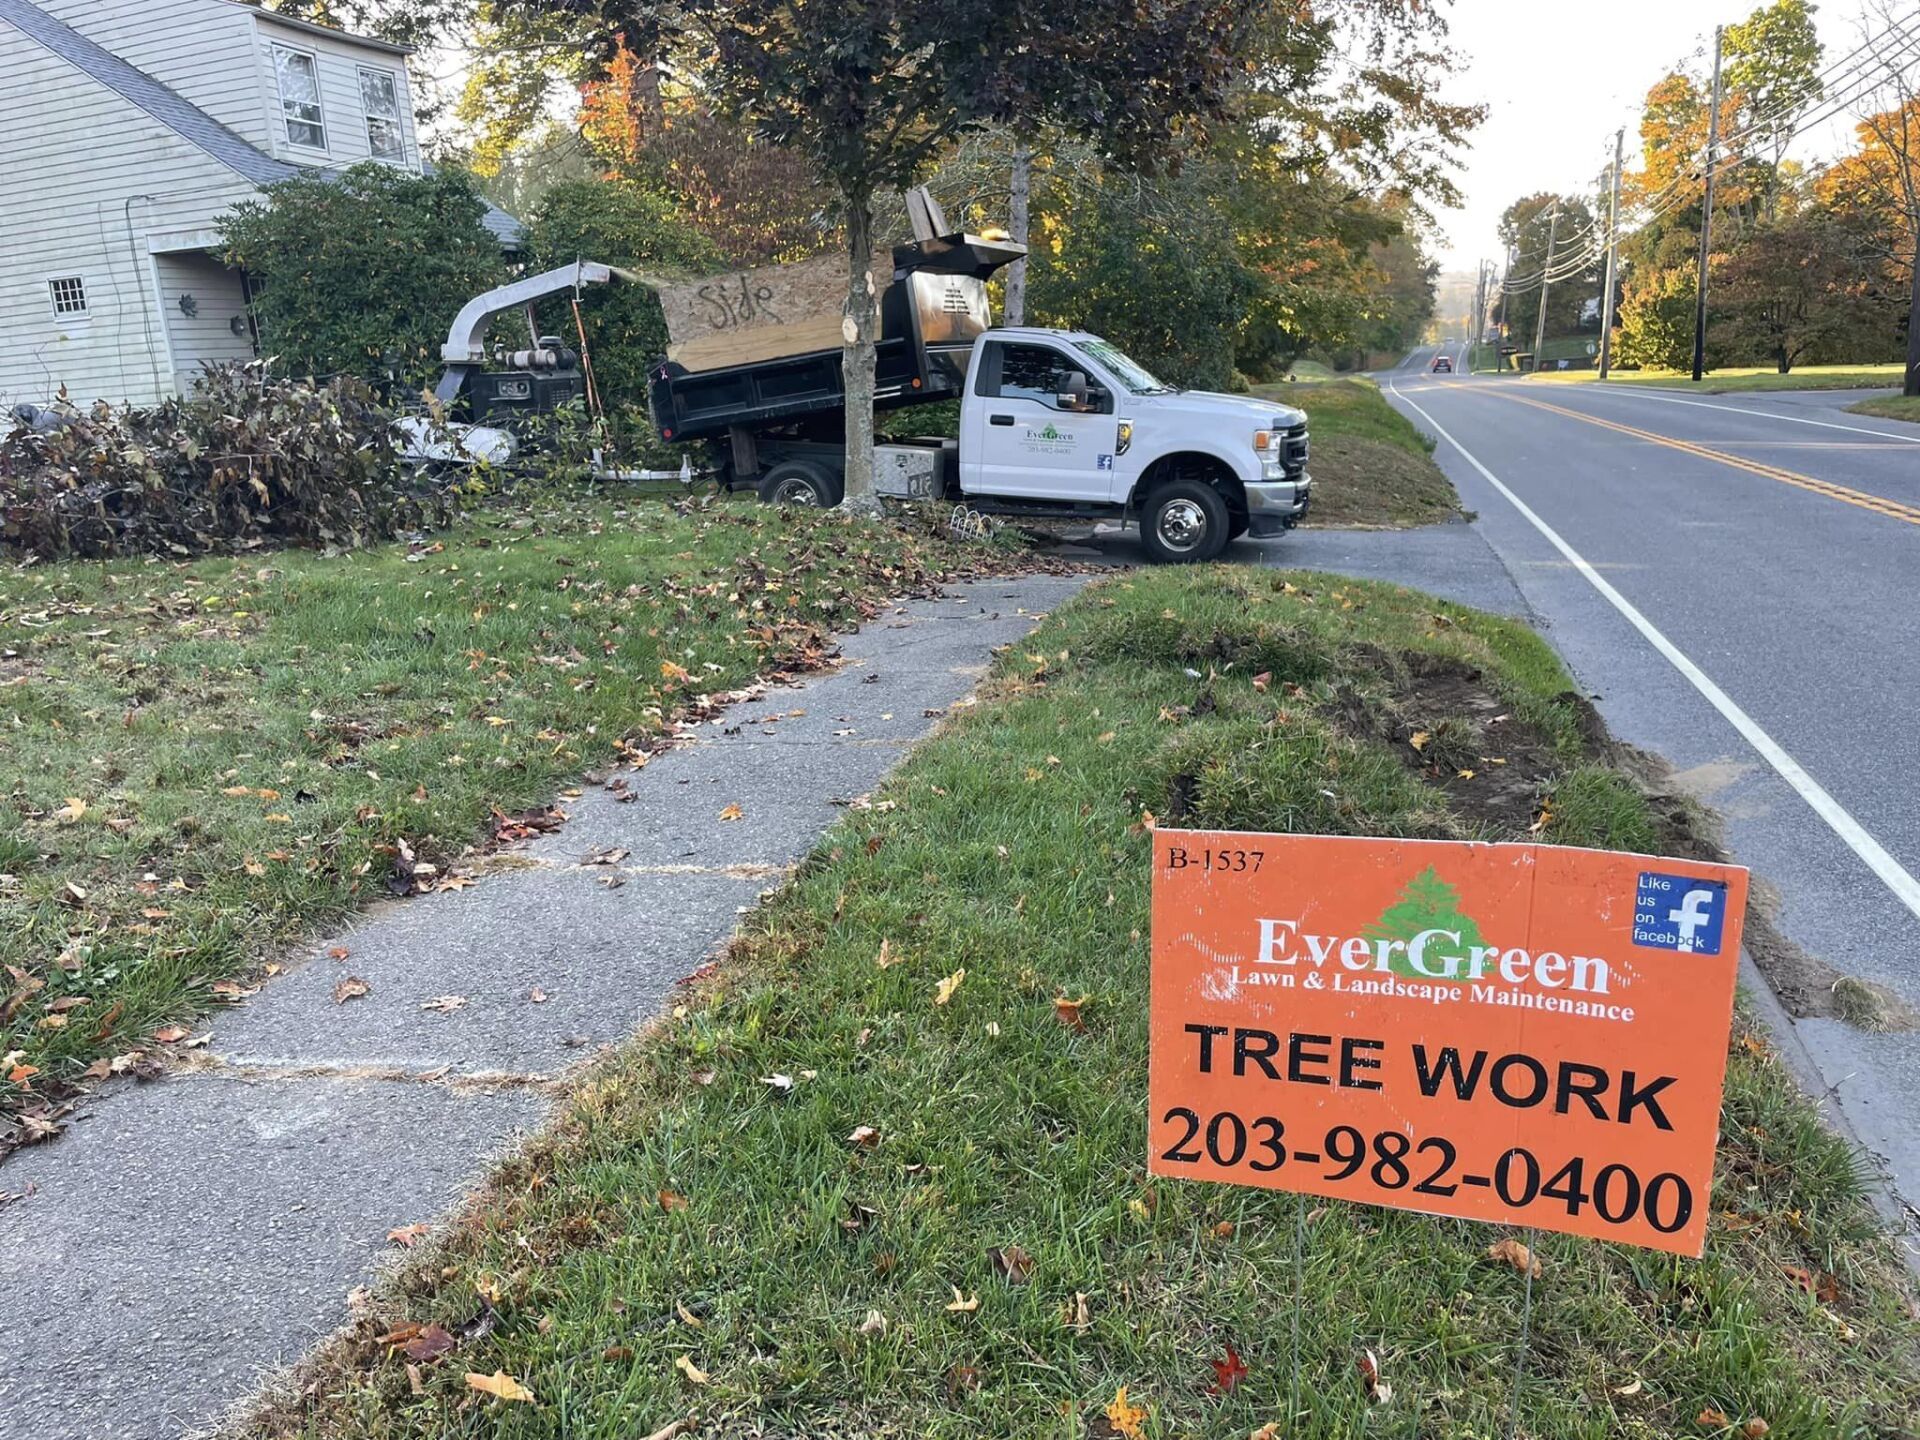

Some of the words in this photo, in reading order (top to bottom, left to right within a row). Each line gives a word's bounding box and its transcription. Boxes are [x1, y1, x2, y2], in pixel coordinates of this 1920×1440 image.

[700, 275, 785, 330] Side
[1026, 430, 1073, 440] EverGreen
[1168, 847, 1265, 873] B-1537
[1639, 875, 1671, 891] Like
[1637, 896, 1656, 907] us
[1635, 913, 1655, 924] on
[1634, 927, 1705, 948] facebook
[1252, 917, 1611, 995] EverGreen
[1231, 965, 1295, 988] Lawn
[1303, 971, 1326, 990] &
[1333, 972, 1462, 1005] Landscape
[1469, 983, 1635, 1023] Maintenance
[1184, 1023, 1386, 1092] TREE
[1412, 1043, 1680, 1132] WORK
[1160, 1107, 1693, 1234] 203-982-0400
